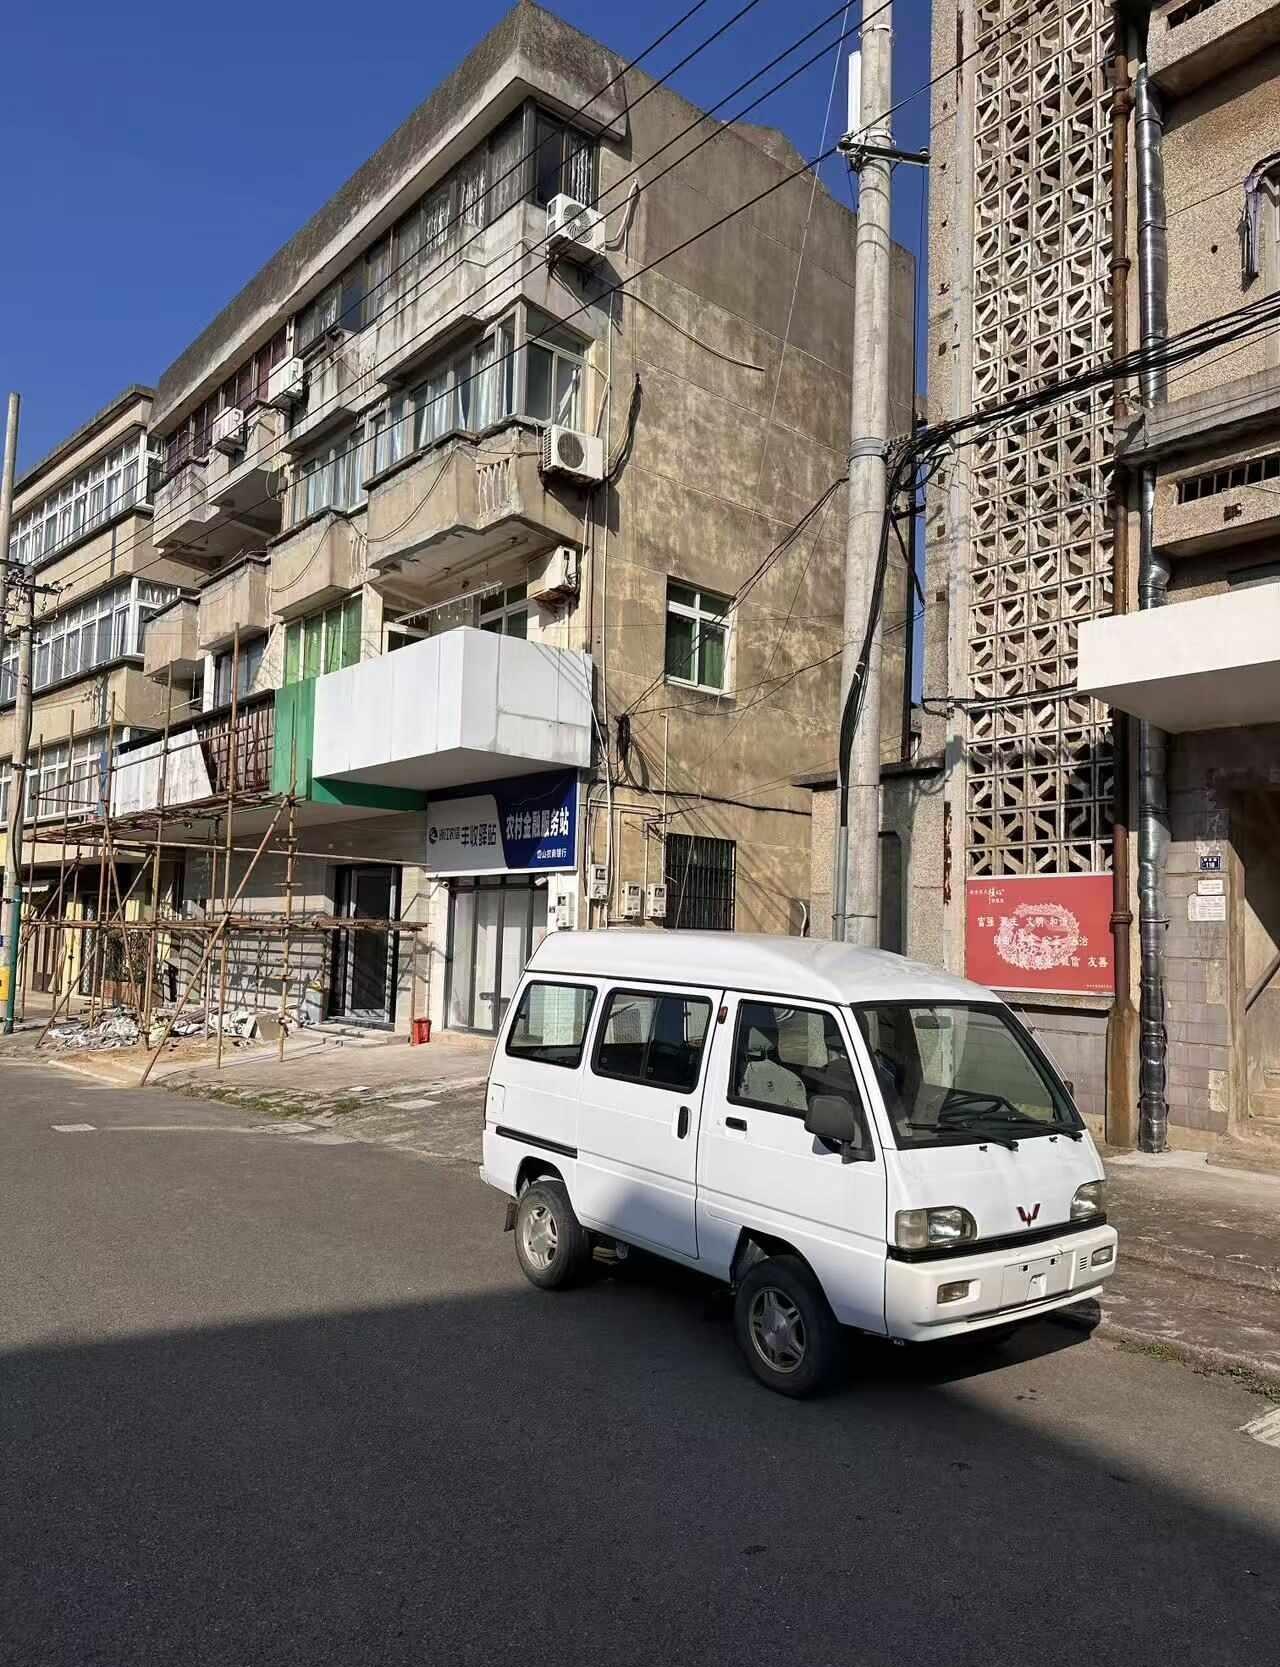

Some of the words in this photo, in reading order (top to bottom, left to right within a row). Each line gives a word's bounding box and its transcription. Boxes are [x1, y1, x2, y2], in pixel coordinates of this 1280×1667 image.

[506, 806, 569, 840] 农村金融服务站
[461, 824, 496, 847] 丰收驿站
[977, 916, 994, 928] 富强
[1025, 916, 1044, 928] 文明
[1087, 957, 1108, 968] 友善
